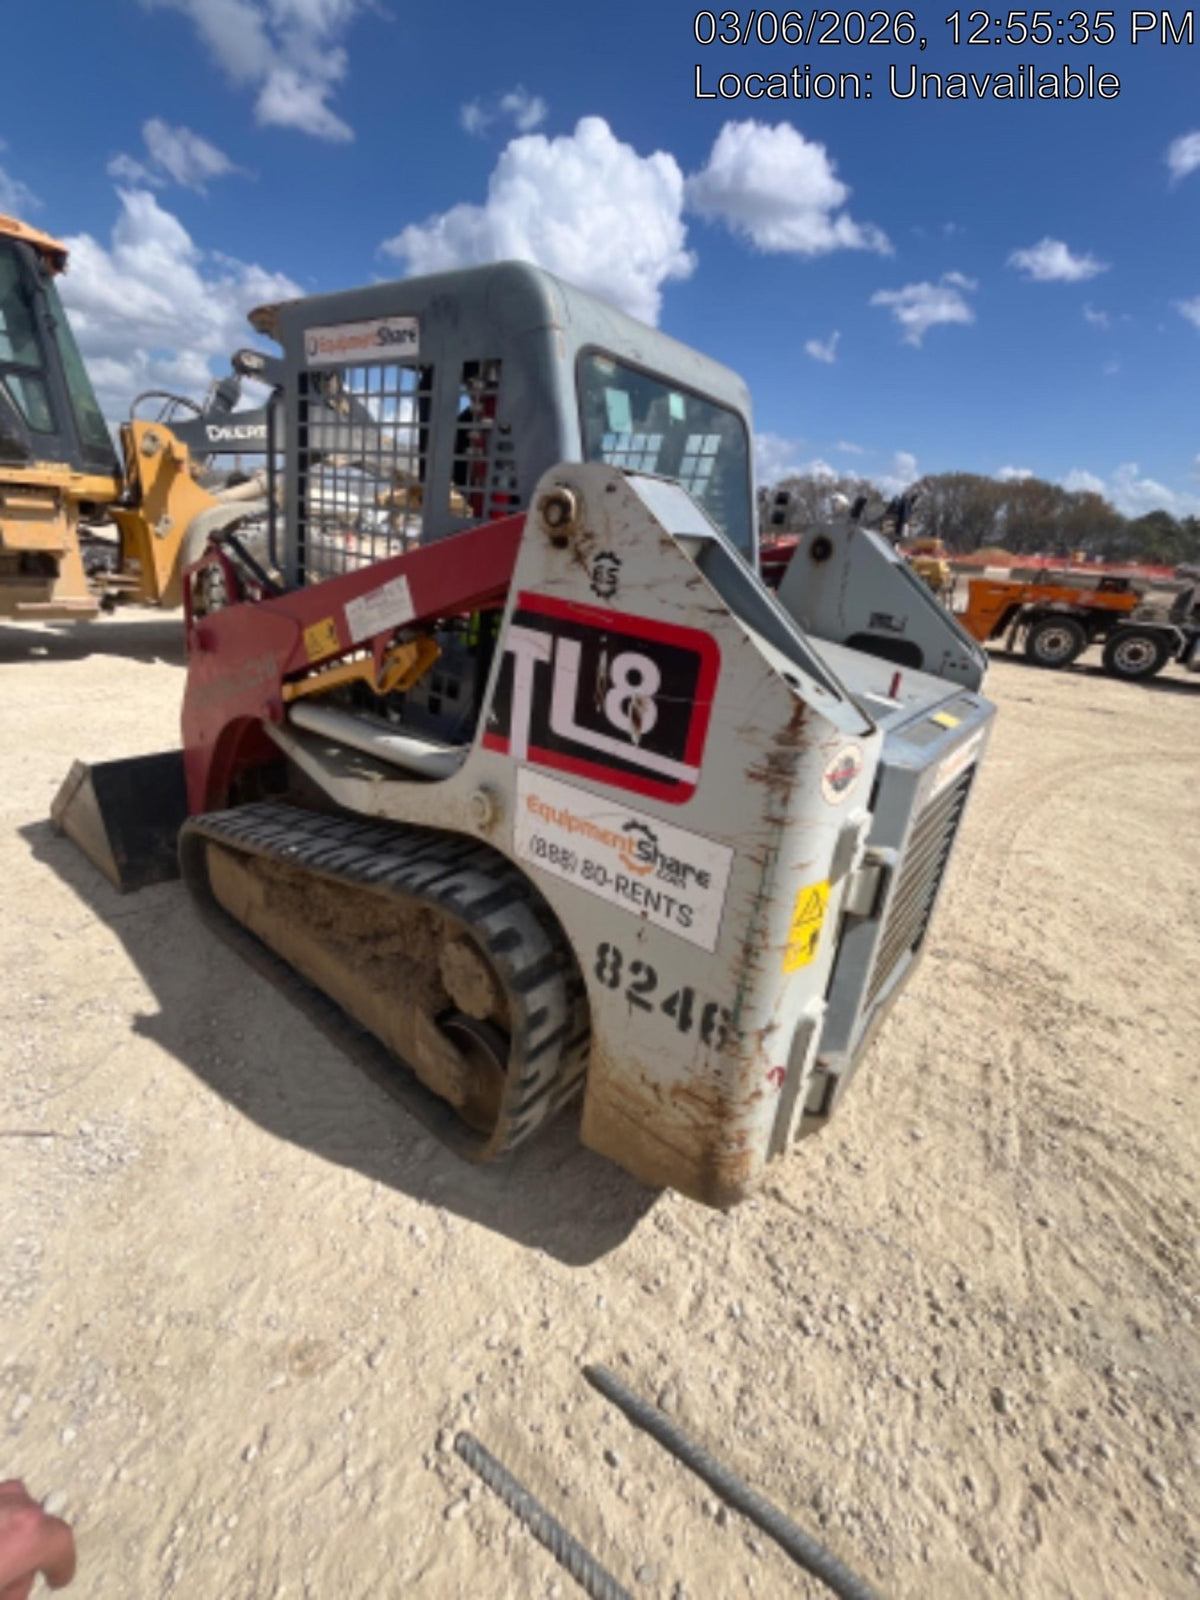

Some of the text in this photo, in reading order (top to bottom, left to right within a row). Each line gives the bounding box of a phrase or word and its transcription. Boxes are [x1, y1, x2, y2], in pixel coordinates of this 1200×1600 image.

[502, 624, 700, 785] TL8
[529, 833, 694, 928] (888) 80-RENTS
[594, 942, 734, 1050] 8246
